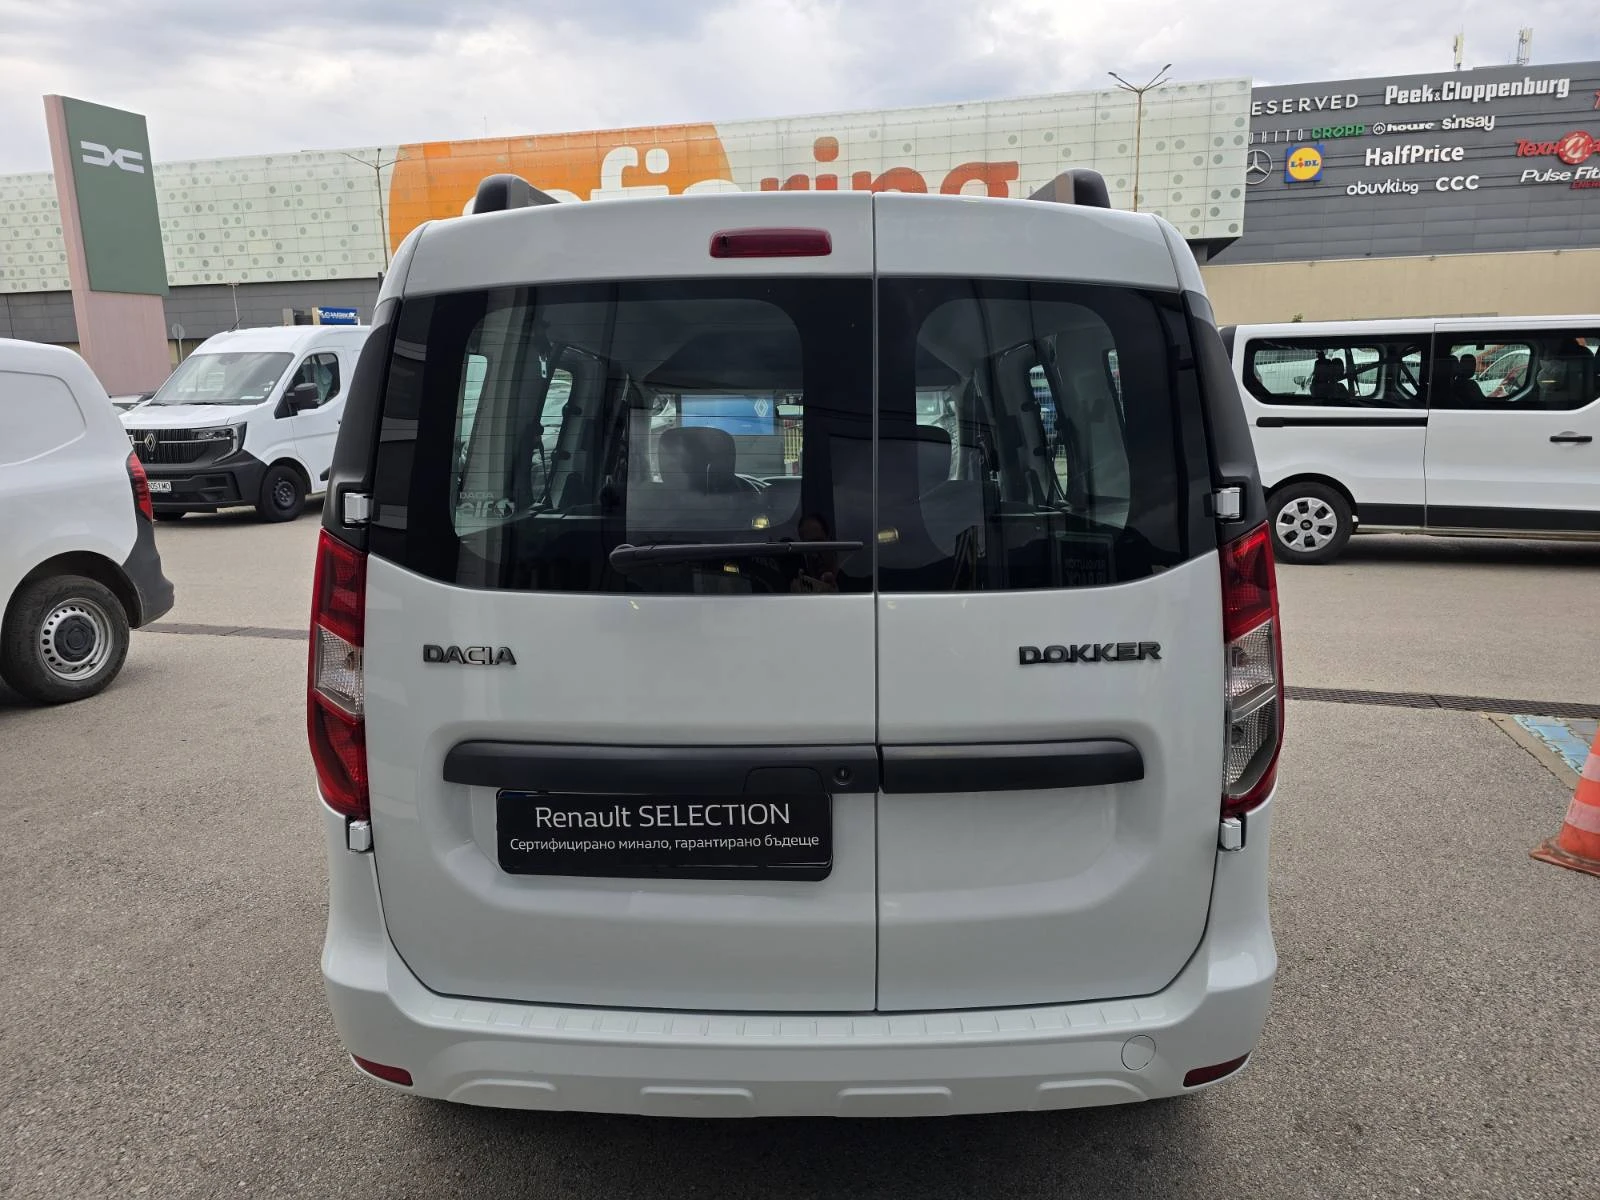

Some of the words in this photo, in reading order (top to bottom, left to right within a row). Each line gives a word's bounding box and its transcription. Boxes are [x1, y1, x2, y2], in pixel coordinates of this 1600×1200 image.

[1311, 123, 1366, 140] CROPP
[1441, 114, 1496, 132] sinsay
[1365, 144, 1465, 167] HalfPrice
[1435, 175, 1480, 192] CCC
[1520, 168, 1572, 183] Pulse
[1346, 178, 1419, 196] obuvki.bg
[422, 644, 517, 666] DACIA
[1018, 641, 1162, 665] DOKKER
[535, 805, 633, 829] Renault
[638, 802, 791, 827] SELECTION
[509, 838, 616, 853] Сертифицирано
[618, 838, 673, 851] минало,
[674, 836, 762, 850] гарантирано
[764, 834, 820, 849] бъдеще
